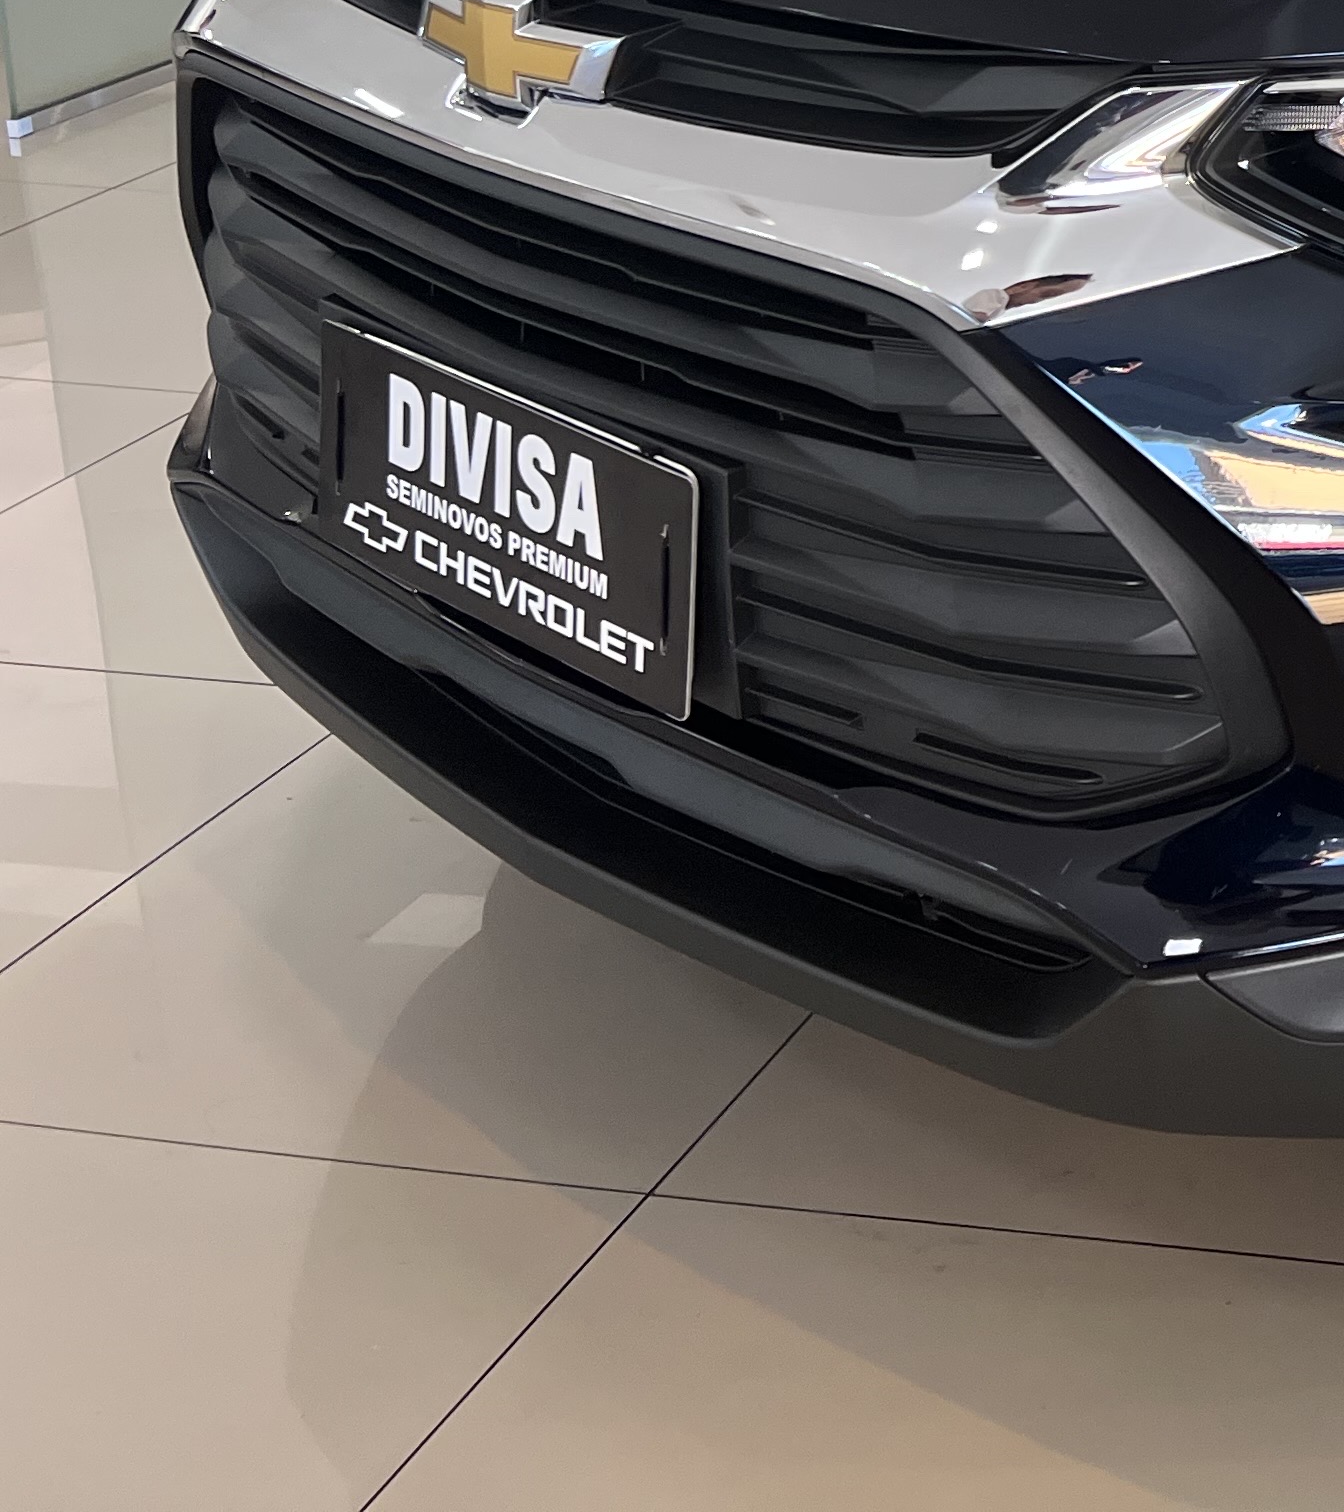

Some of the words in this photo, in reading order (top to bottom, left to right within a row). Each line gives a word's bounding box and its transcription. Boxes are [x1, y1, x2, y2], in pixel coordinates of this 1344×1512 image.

[386, 473, 504, 550] SEMINOVOS
[507, 532, 608, 600] PREMIUM
[387, 372, 604, 561] DIVISA
[414, 529, 654, 673] CHEVROLET
